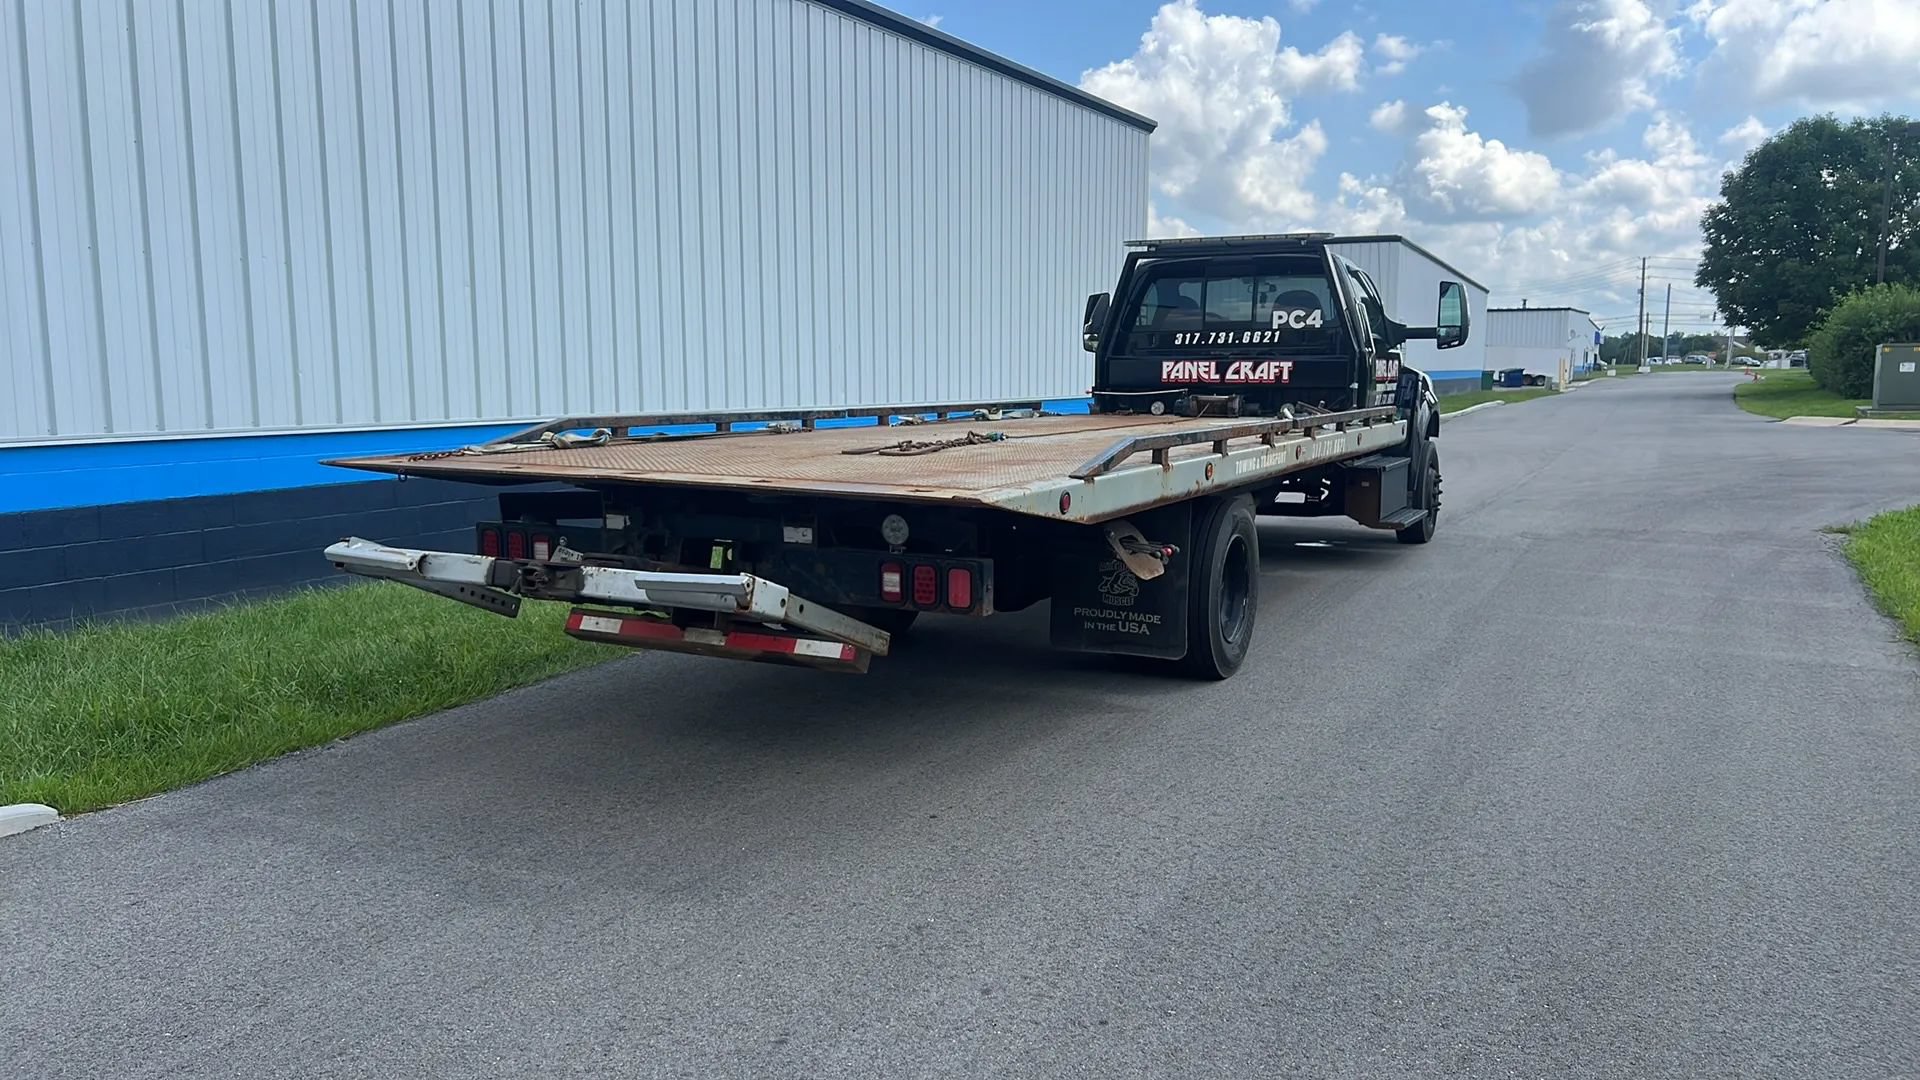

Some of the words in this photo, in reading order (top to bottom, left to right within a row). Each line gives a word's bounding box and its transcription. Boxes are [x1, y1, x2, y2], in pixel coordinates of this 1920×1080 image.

[1272, 309, 1323, 329] PC4
[1174, 330, 1281, 345] 317.731.6621
[1162, 360, 1221, 383] PANEL
[1224, 360, 1293, 384] CRAFT
[1073, 607, 1128, 620] PROUDLY
[1129, 611, 1161, 625] MADE
[1084, 621, 1095, 630] IN
[1096, 622, 1117, 632] THE
[1118, 621, 1151, 635] USA
